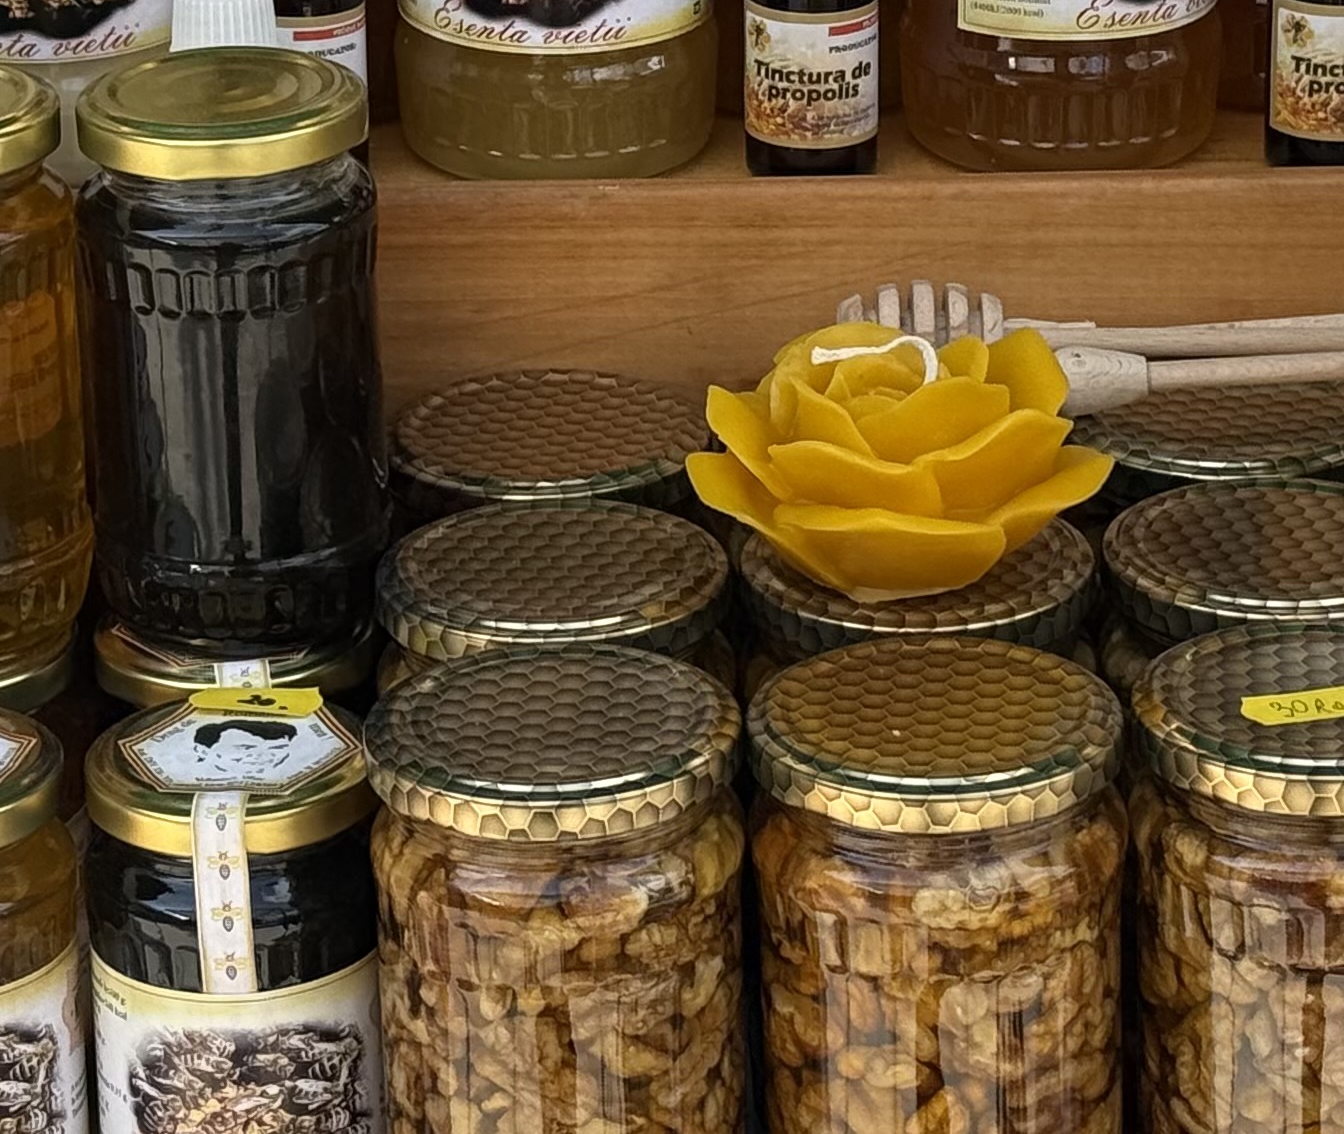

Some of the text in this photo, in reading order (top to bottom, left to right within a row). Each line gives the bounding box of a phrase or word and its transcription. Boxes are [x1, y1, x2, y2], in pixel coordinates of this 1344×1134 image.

[754, 59, 871, 84] Tinctura de
[768, 82, 860, 106] propolis
